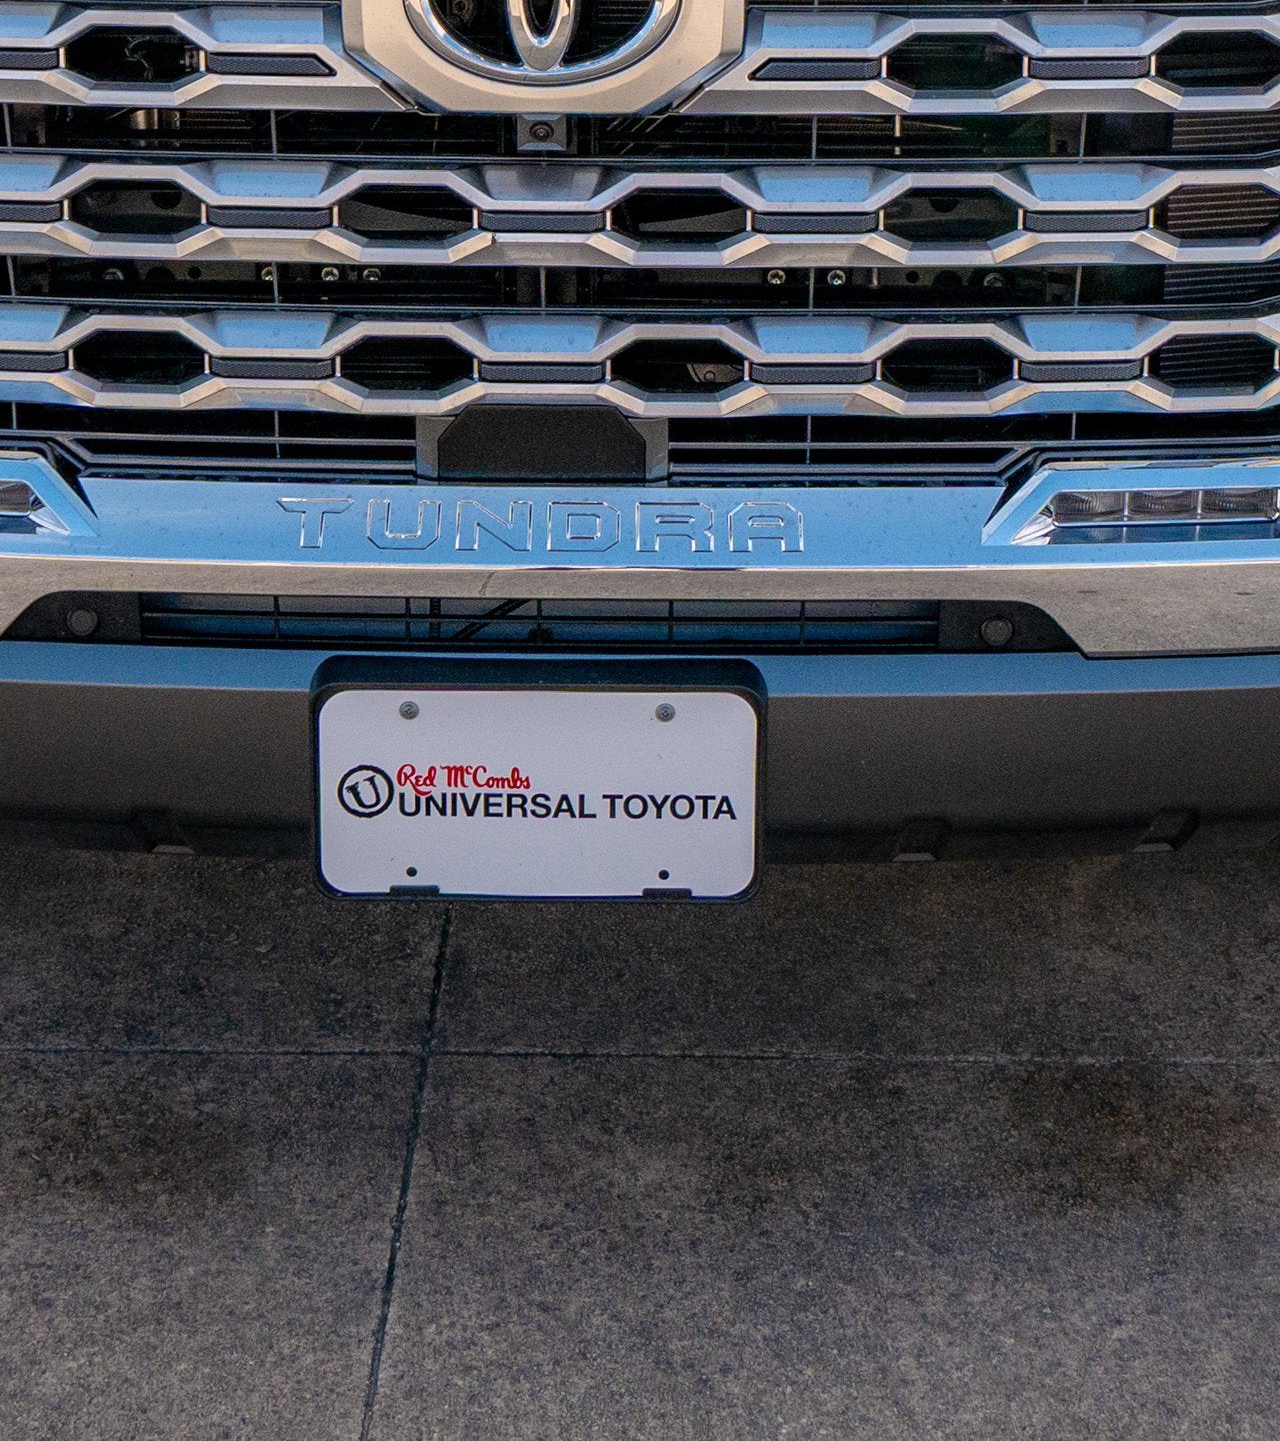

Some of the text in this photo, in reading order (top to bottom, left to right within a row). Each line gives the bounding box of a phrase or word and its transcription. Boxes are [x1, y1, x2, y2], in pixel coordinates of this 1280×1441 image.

[275, 496, 804, 553] TUNDRA
[396, 763, 532, 797] Red McCombs
[399, 792, 737, 821] UNIVERSAL TOYOTA
